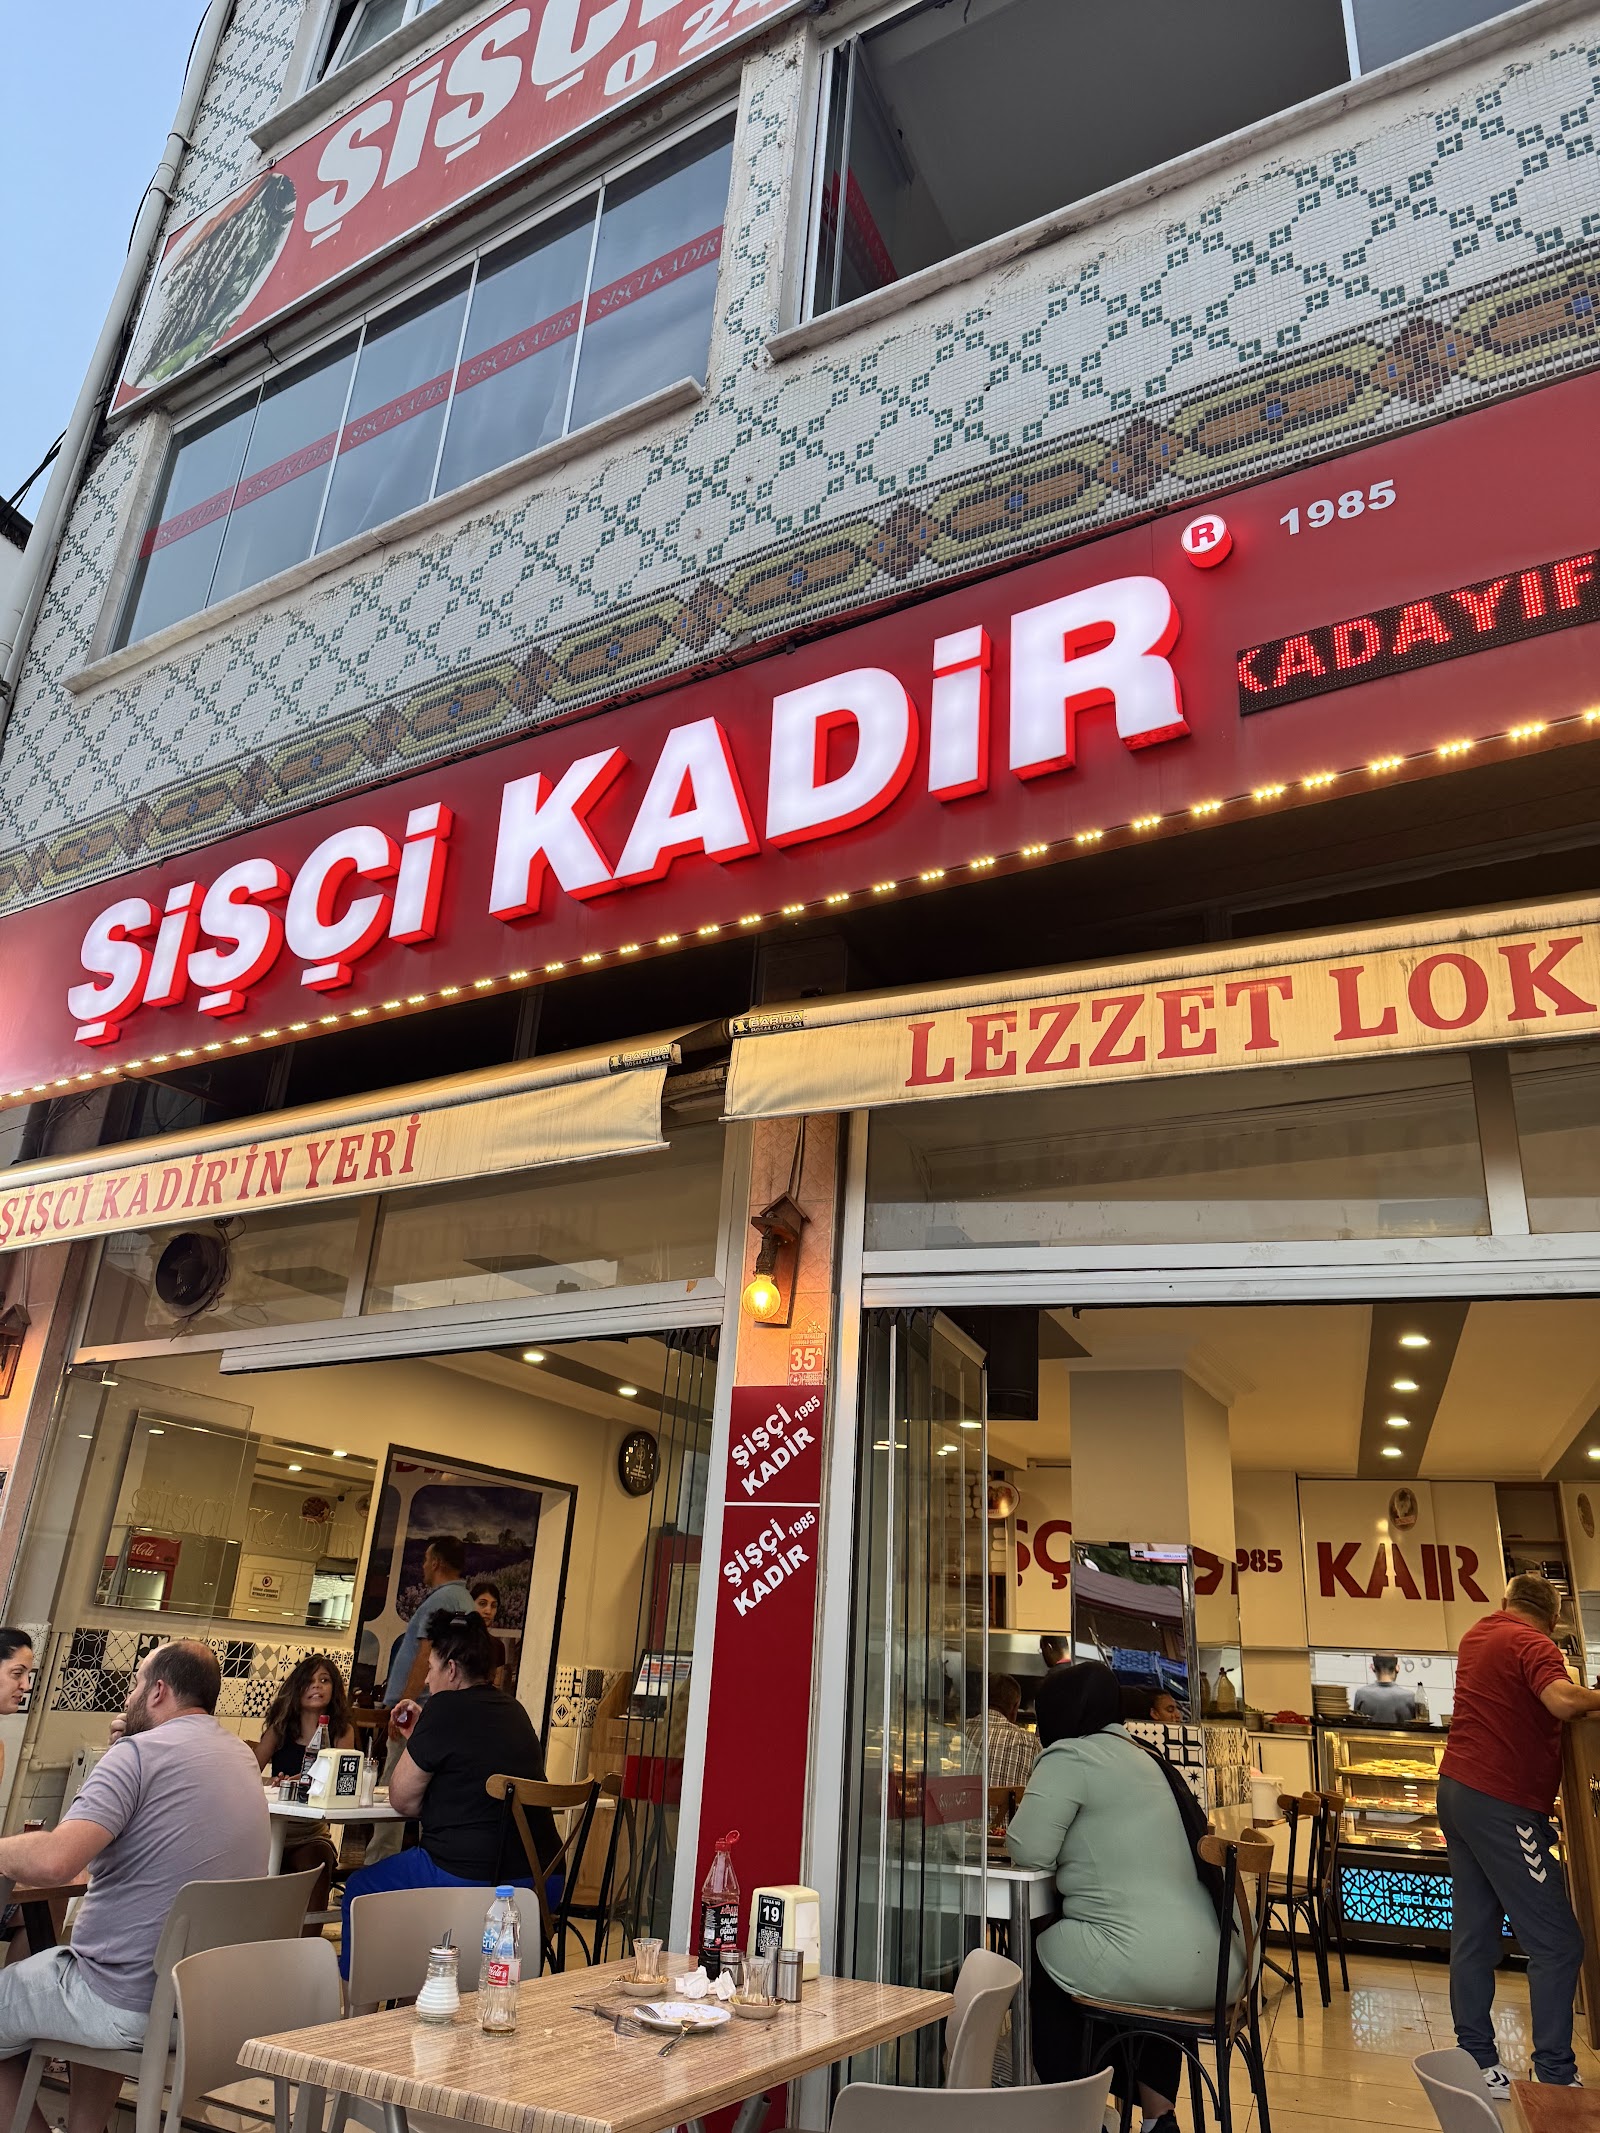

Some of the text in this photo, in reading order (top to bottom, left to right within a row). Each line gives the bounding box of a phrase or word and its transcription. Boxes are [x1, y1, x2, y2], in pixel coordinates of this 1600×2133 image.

[304, 0, 685, 248] ŞİŞÇ
[1280, 479, 1397, 536] 1985
[67, 801, 452, 1046] ŞİŞÇİ
[488, 575, 1188, 918] KADİR
[905, 936, 1597, 1087] LEZZET LOK
[99, 1143, 293, 1222] KADİR'İN
[305, 1113, 422, 1190] YERİ
[731, 1395, 821, 1469] ŞİŞÇİ 1985
[741, 1426, 816, 1496] KADİR
[723, 1511, 816, 1587] ŞİŞÇİ 1985
[732, 1544, 810, 1617] KADİR
[1236, 1548, 1283, 1573] 985
[342, 1761, 356, 1772] 16
[763, 1905, 780, 1923] 19
[1425, 1897, 1453, 1908] KADİ
